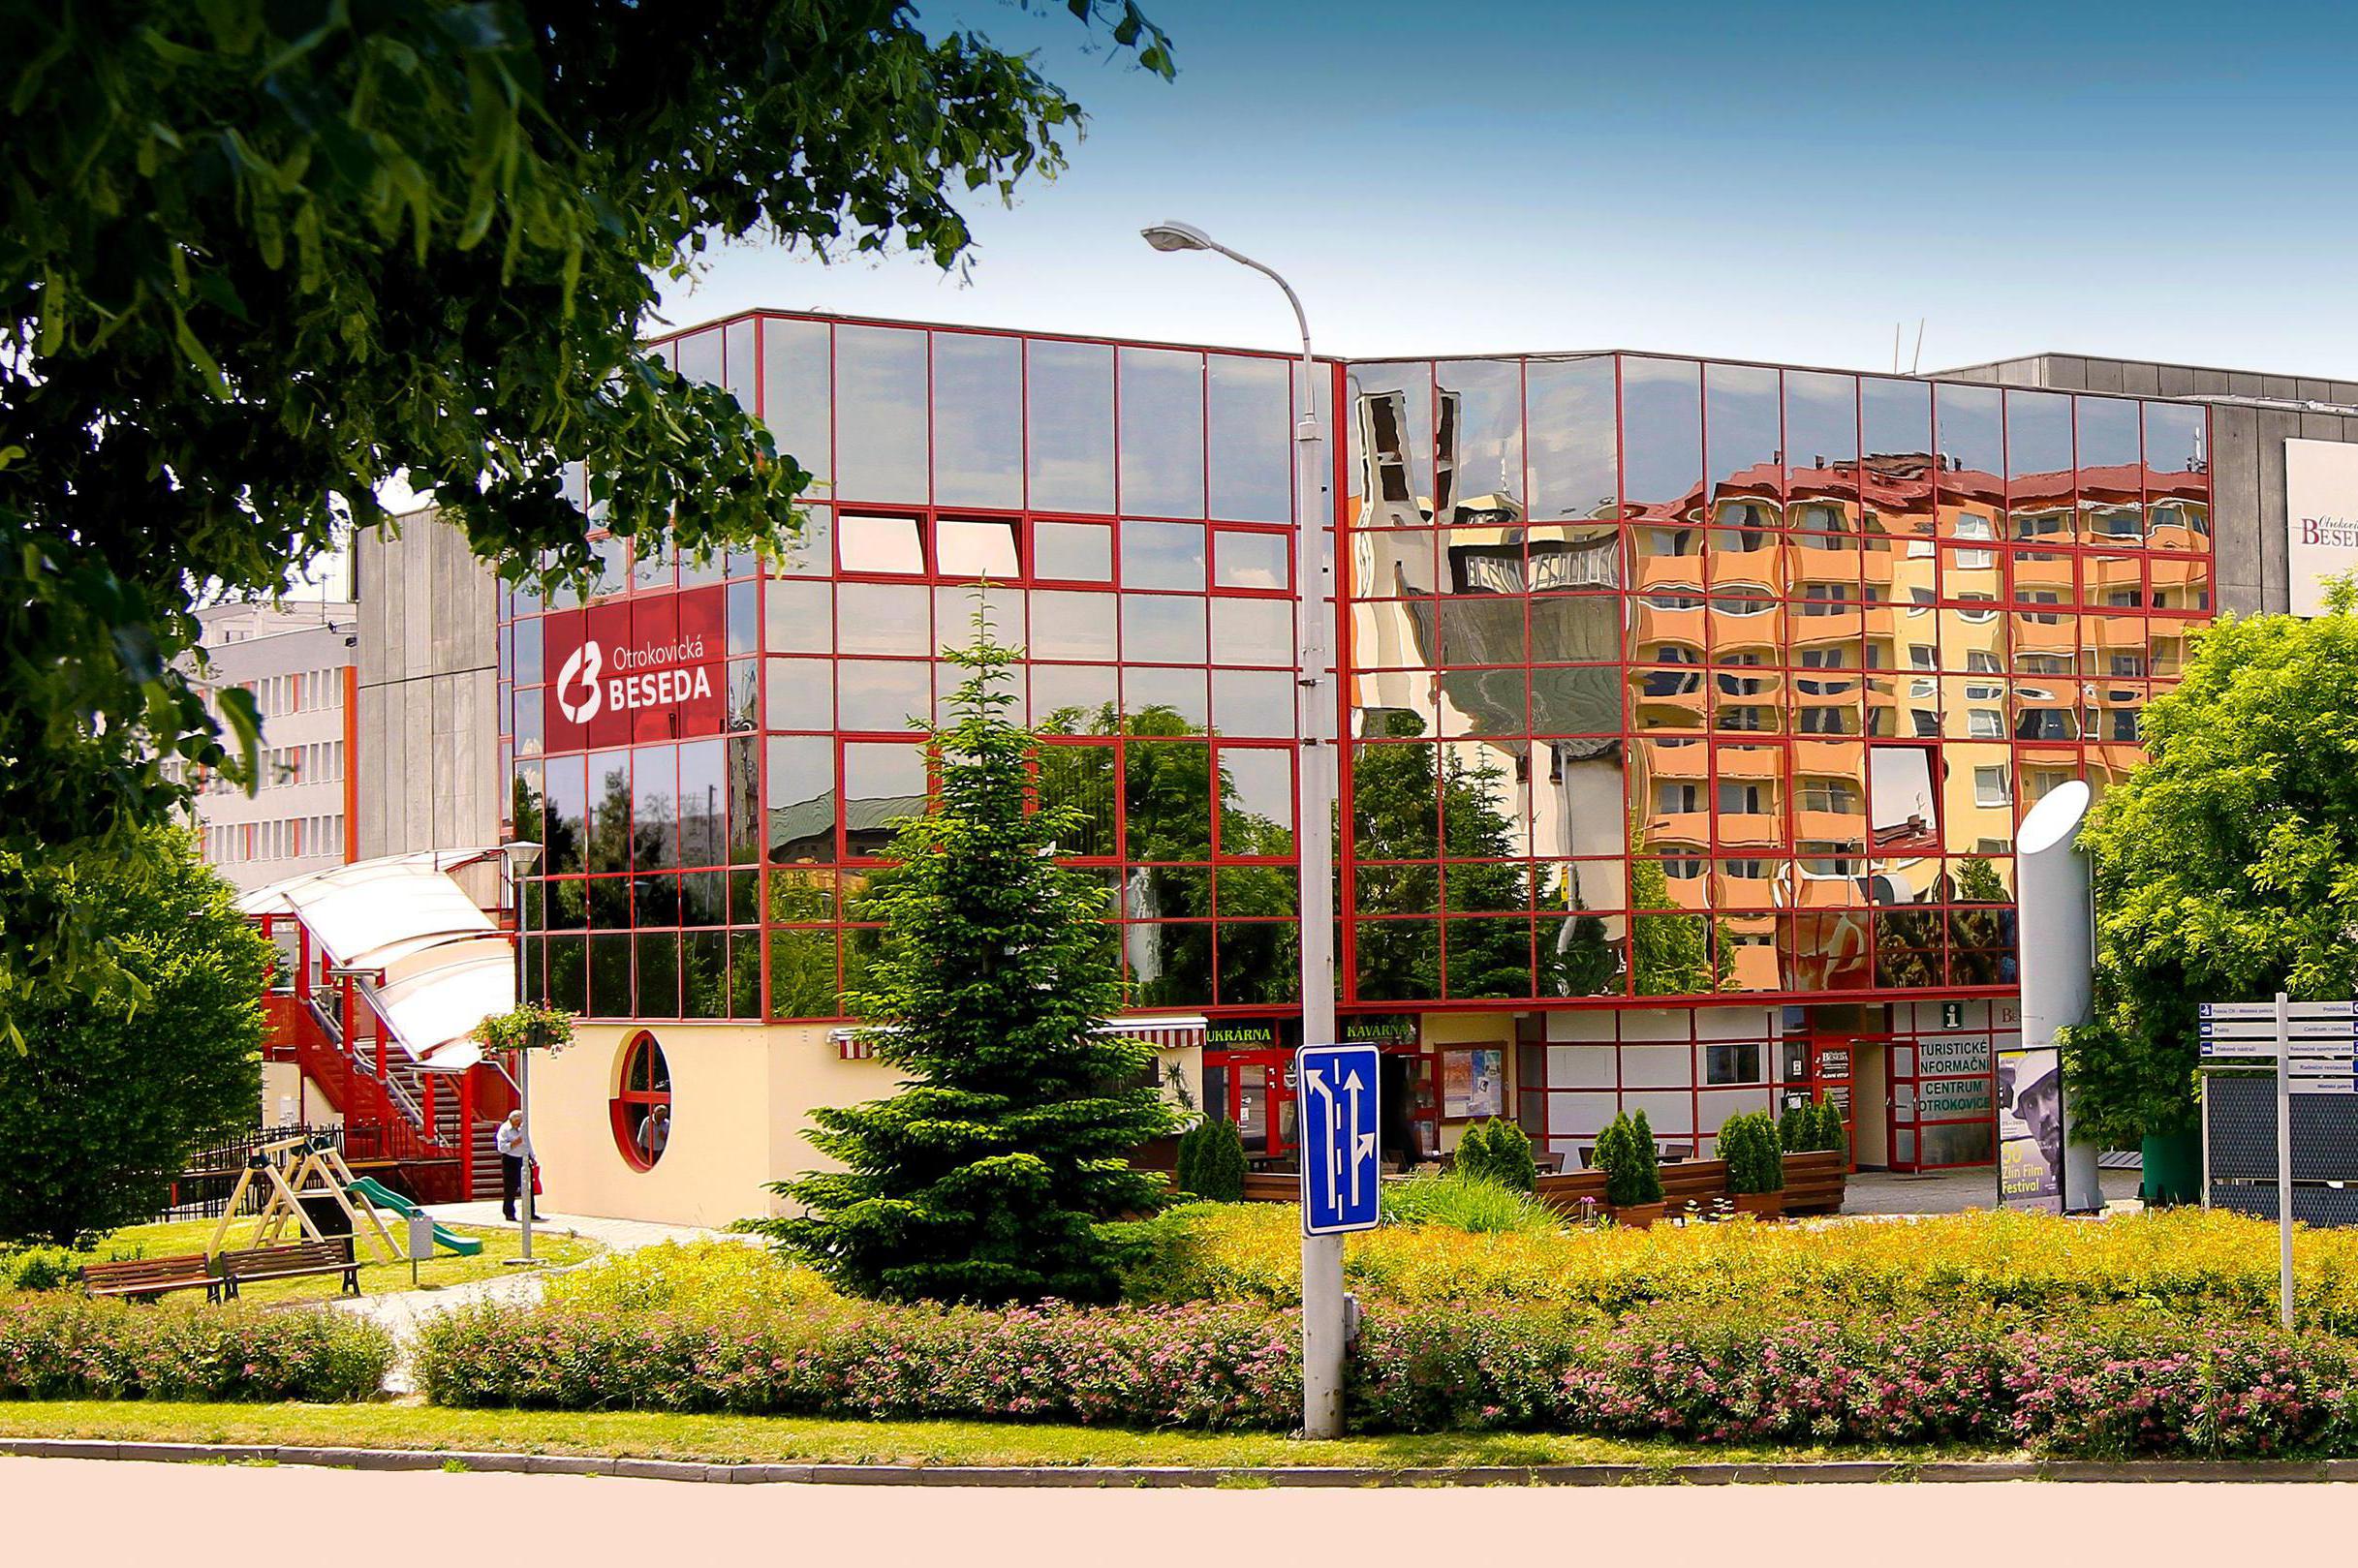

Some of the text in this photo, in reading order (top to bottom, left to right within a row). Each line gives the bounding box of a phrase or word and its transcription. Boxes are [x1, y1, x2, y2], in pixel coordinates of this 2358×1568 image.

[613, 634, 704, 671] Otrokovická
[609, 665, 712, 712] BESEDA
[1206, 1026, 1271, 1042] UKRÁRNA
[1919, 1039, 1988, 1056] TURISTICKÉ
[1920, 1057, 1990, 1073] NFORMAČNÍ
[1925, 1081, 1982, 1094] CENTRUM
[1919, 1096, 1990, 1113] OTROKOVICE
[2024, 1163, 2044, 1177] Film
[2002, 1178, 2039, 1194] Festival
